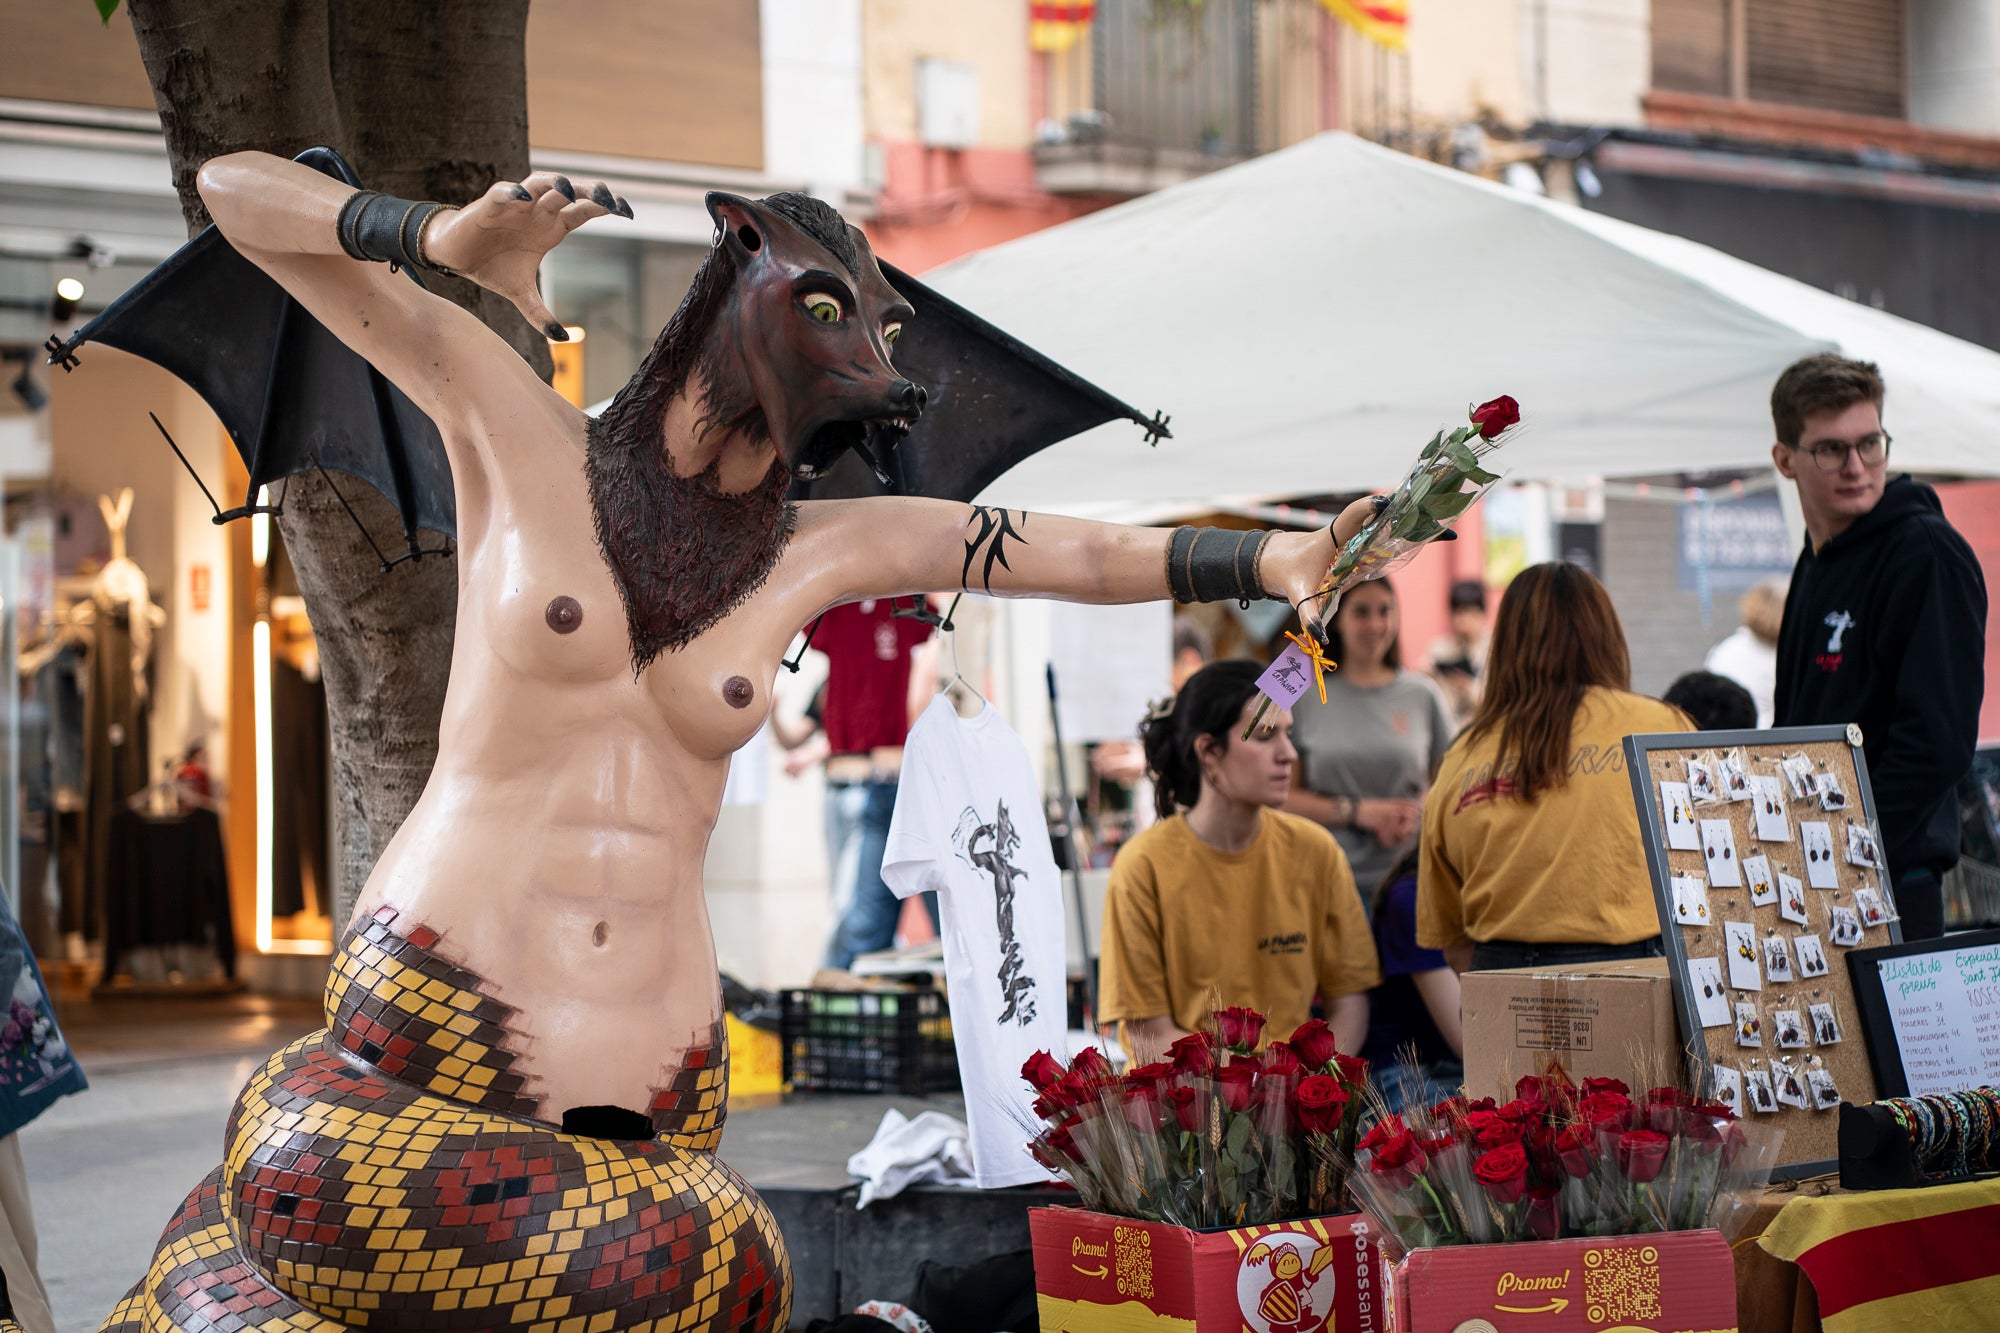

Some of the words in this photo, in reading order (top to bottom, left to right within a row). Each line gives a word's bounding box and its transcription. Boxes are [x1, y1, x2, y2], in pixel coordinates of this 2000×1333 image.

[1928, 955, 1942, 973] de
[1955, 947, 2000, 969] Especial
[1960, 969, 1986, 985] Sant
[1898, 978, 1936, 1000] preus
[1576, 1035, 1588, 1046] UN
[1072, 1236, 1109, 1258] Promo!
[1497, 1269, 1571, 1297] Promo!
